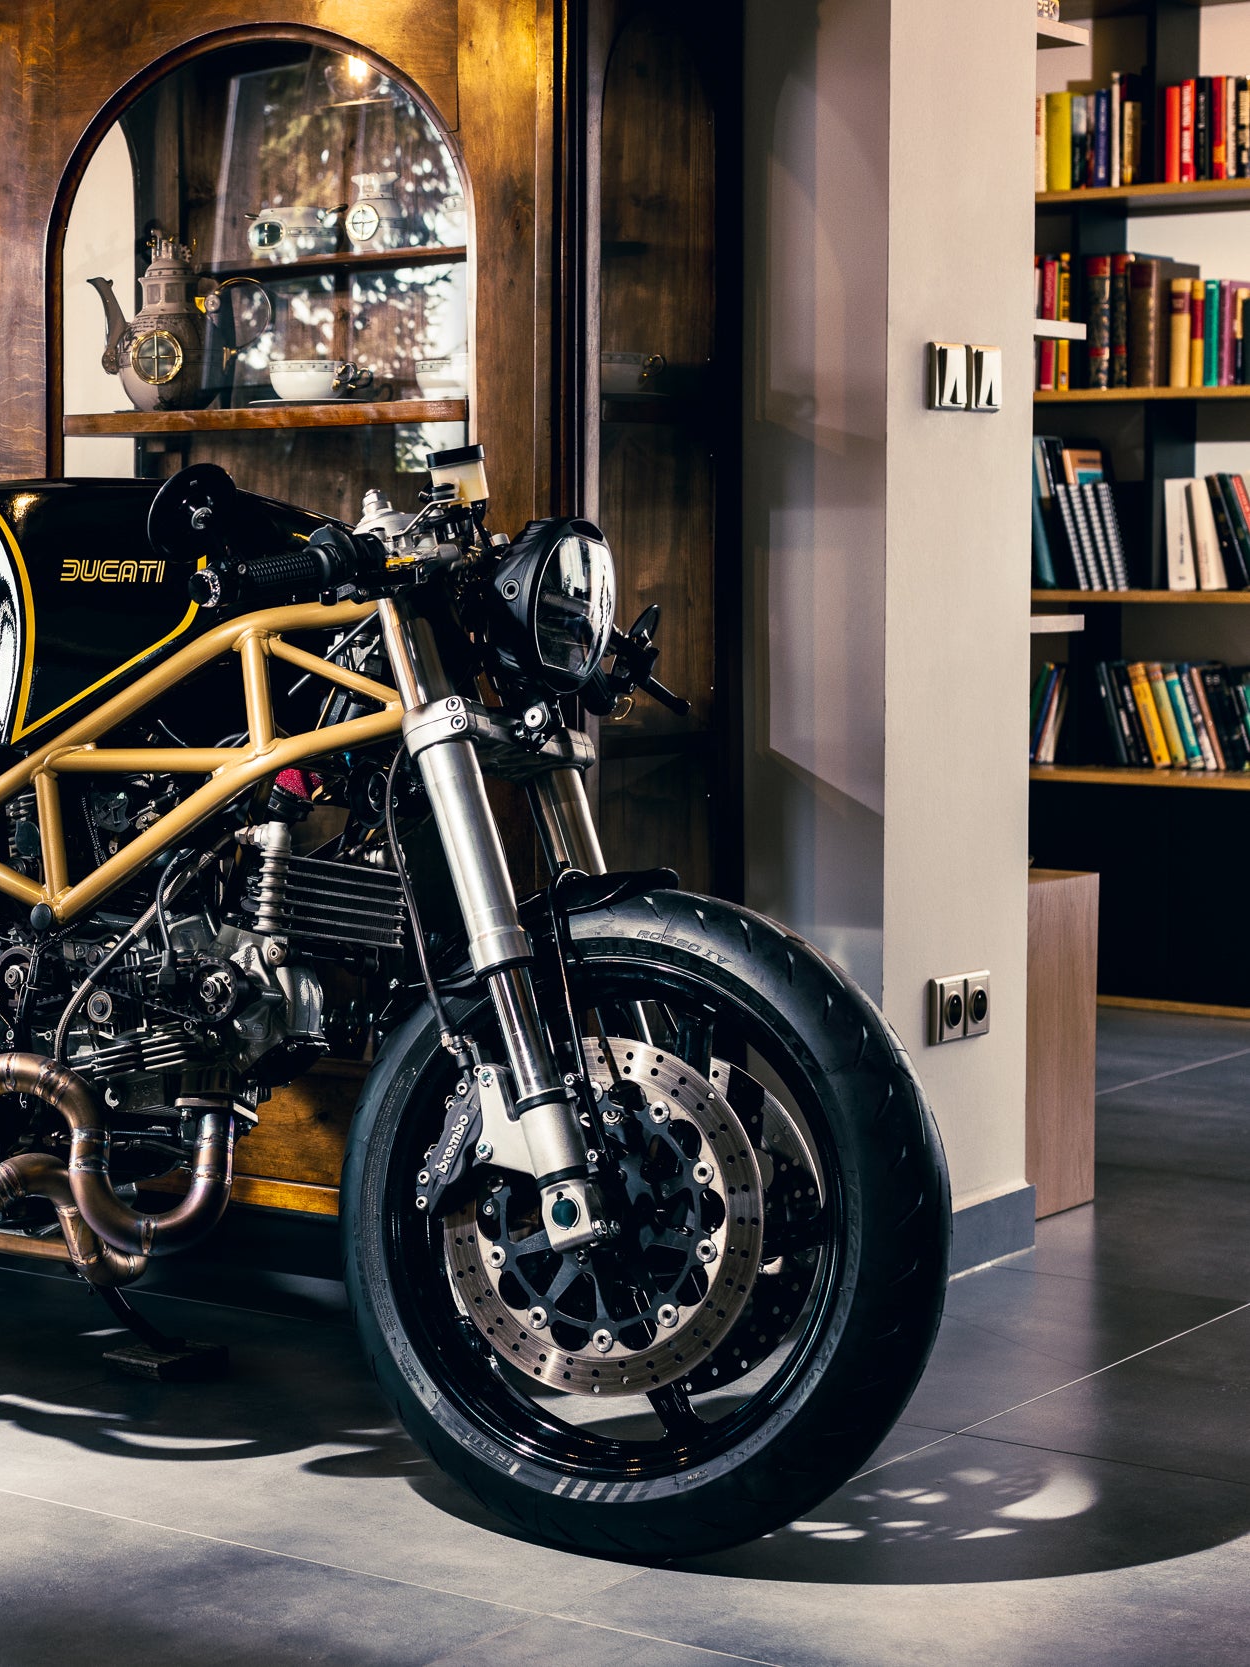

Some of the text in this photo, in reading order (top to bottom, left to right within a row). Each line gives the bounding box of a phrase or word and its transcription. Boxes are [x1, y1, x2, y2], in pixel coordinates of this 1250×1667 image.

[60, 558, 165, 583] DUCATI
[636, 929, 733, 965] ROSSO IV
[434, 1113, 470, 1175] brembo
